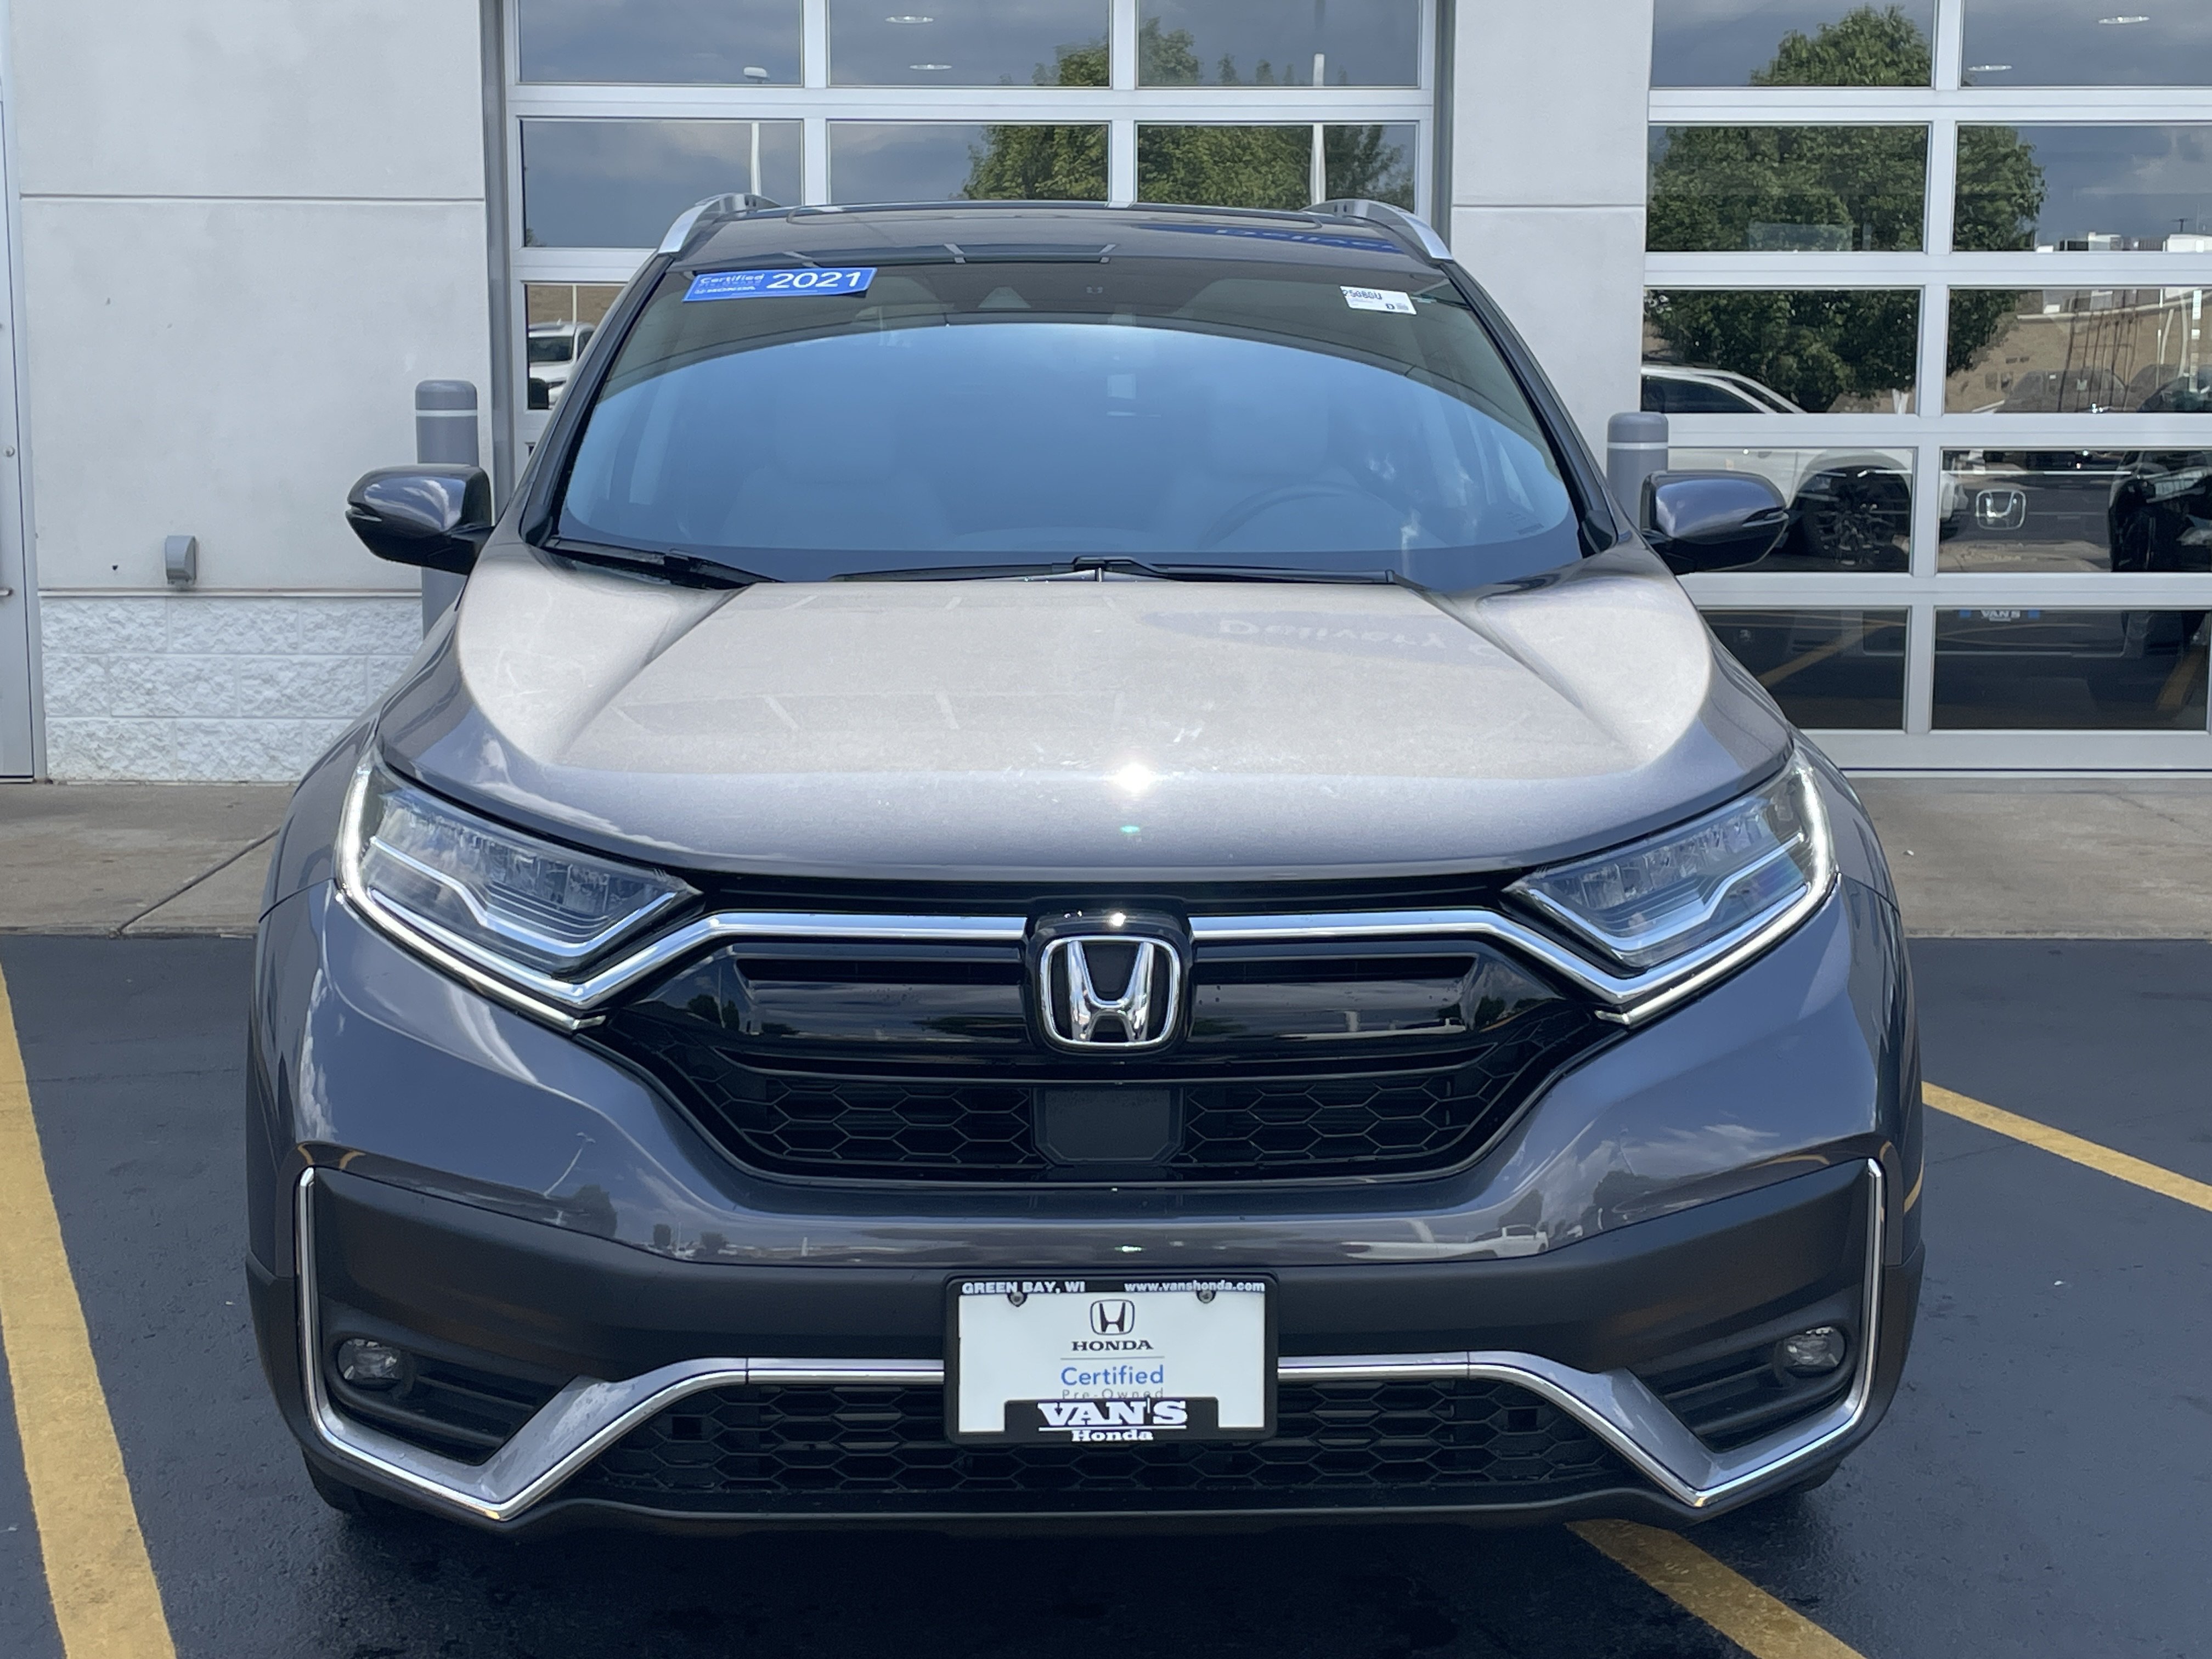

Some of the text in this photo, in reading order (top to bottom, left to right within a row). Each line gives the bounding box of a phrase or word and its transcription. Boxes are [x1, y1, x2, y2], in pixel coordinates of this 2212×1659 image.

[699, 273, 765, 284] Certified
[766, 271, 861, 289] 2021
[961, 1281, 1086, 1295] GREEN BAY, WI
[1124, 1279, 1266, 1292] www.vanshonda.com
[1071, 1339, 1154, 1352] HONDA
[1060, 1364, 1164, 1386] Certified
[1062, 1387, 1164, 1399] Pre-Owned
[1036, 1397, 1188, 1426] VAN'S
[1071, 1429, 1154, 1442] Honda
